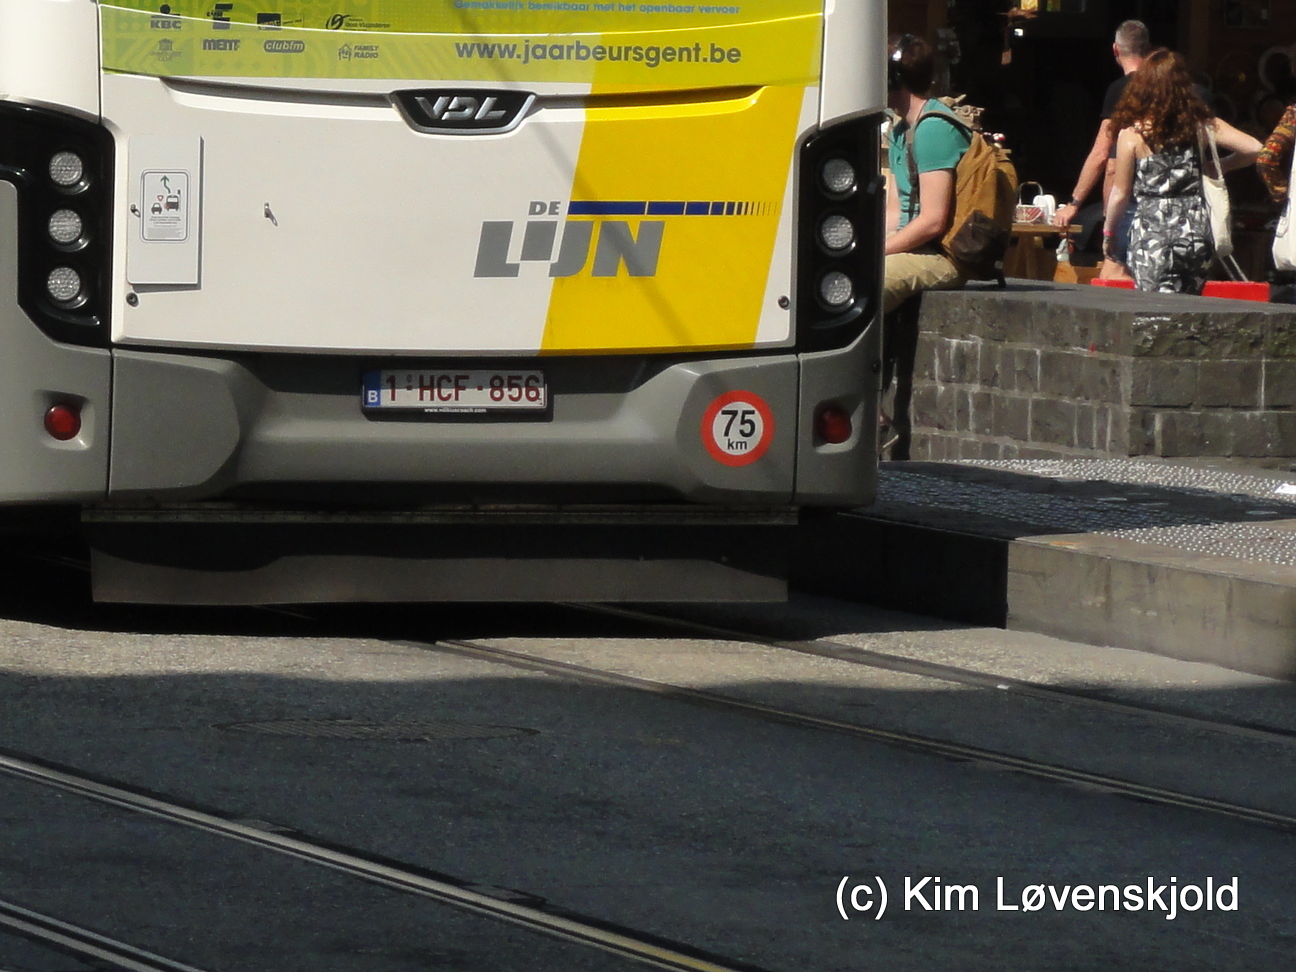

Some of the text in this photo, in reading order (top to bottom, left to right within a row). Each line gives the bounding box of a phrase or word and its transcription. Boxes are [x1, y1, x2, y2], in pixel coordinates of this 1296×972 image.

[593, 2, 615, 12] met
[618, 2, 636, 13] het
[639, 2, 695, 15] openbaar
[698, 4, 741, 14] vervoer
[150, 19, 182, 29] KBC
[265, 40, 305, 52] clubfm
[354, 44, 380, 52] FAMILY
[454, 38, 743, 69] www.jaarbeursgent.be
[414, 96, 507, 121] VDL
[528, 200, 562, 216] DE
[473, 220, 666, 278] LIJN
[367, 389, 379, 404] B
[720, 409, 756, 438] 75
[727, 438, 748, 450] km
